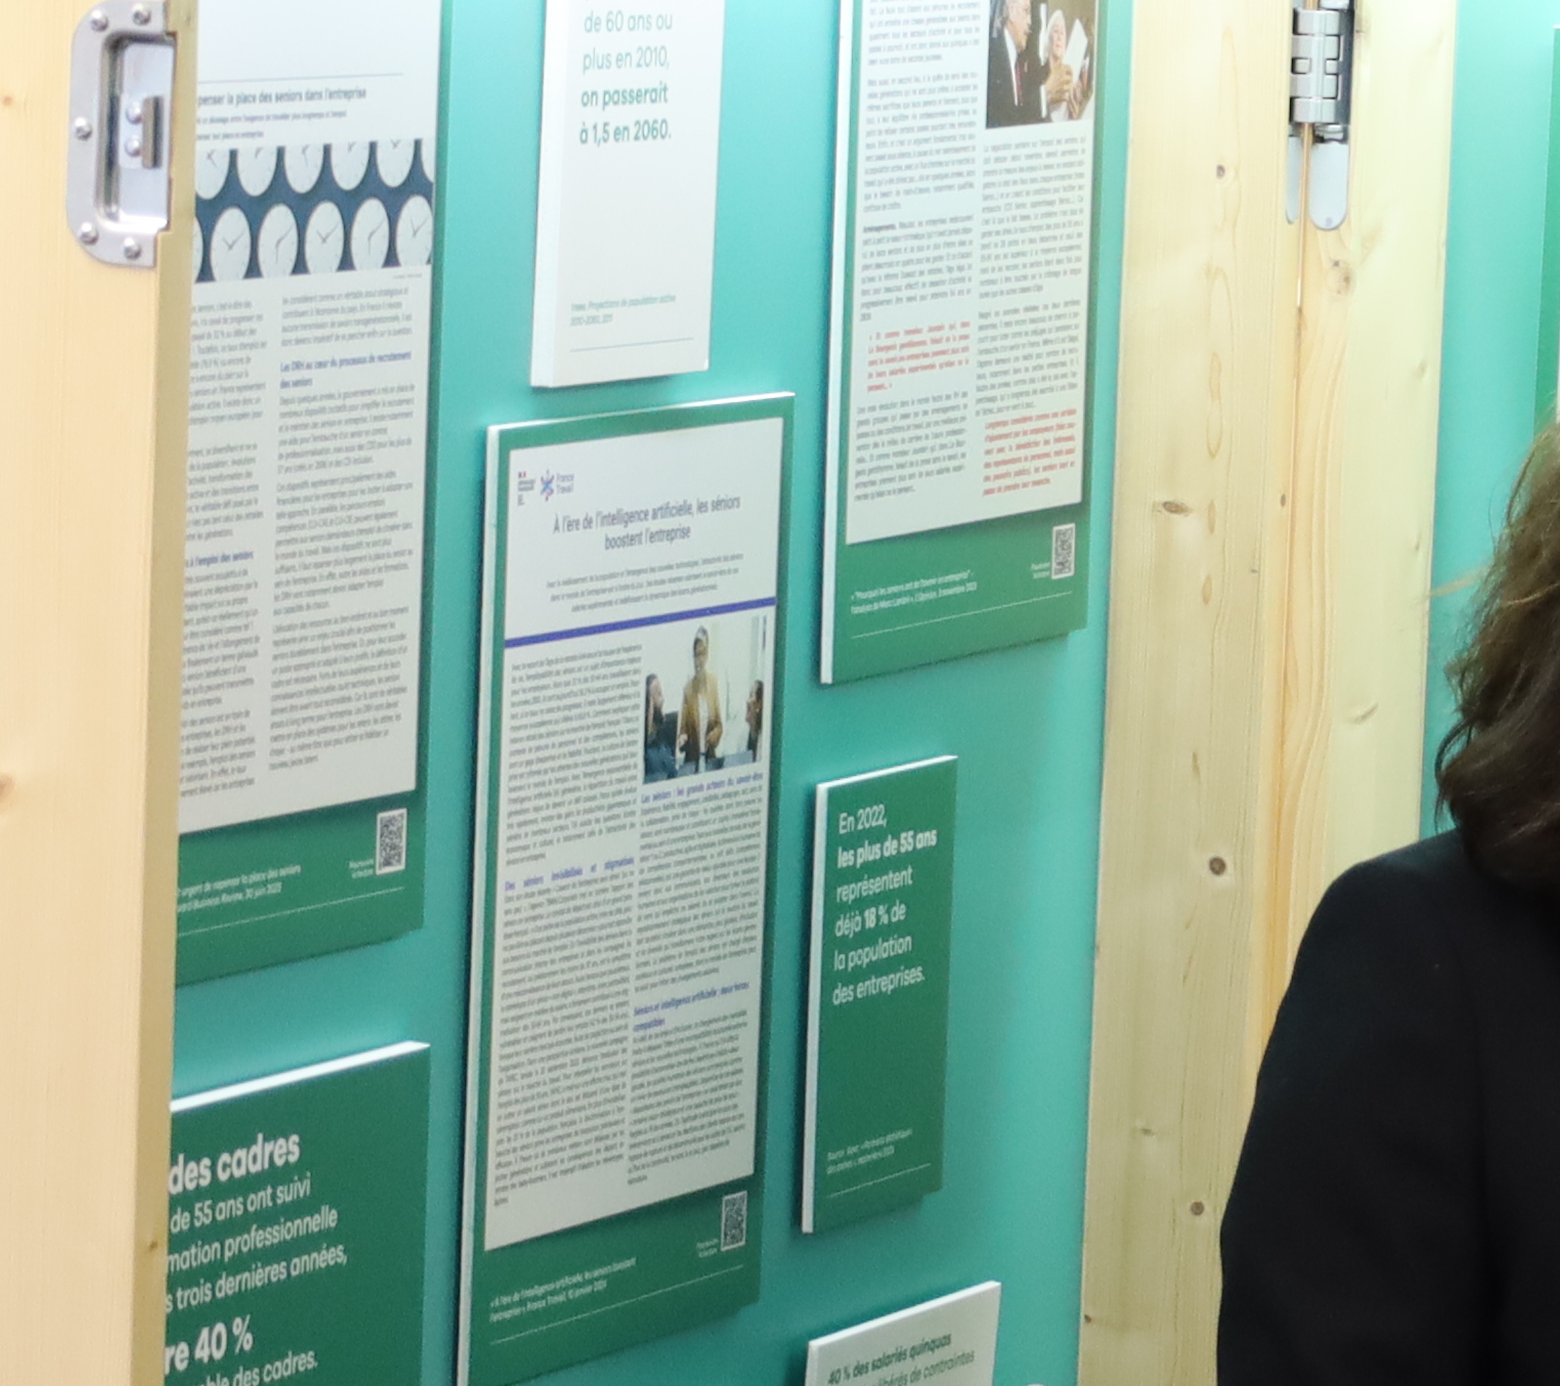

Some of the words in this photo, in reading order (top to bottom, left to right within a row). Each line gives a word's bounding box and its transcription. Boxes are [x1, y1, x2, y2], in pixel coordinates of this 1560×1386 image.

[583, 10, 602, 33] de
[605, 9, 624, 32] 60
[626, 13, 652, 31] ans
[655, 13, 673, 30] ou
[581, 47, 612, 74] plus
[614, 51, 633, 69] en
[635, 45, 669, 68] 2010,
[580, 90, 599, 107] on
[601, 82, 668, 110] passerait
[578, 122, 589, 145] à
[591, 121, 610, 146] 1,5
[612, 125, 630, 142] en
[632, 118, 671, 141] 2060.
[838, 811, 855, 834] En
[856, 804, 887, 830] 2022,
[836, 846, 855, 868] les
[855, 840, 881, 867] plus
[882, 834, 899, 857] de
[898, 830, 914, 853] 55
[914, 829, 937, 849] ans
[835, 866, 913, 903] représentent
[834, 910, 862, 937] déjà
[863, 906, 877, 929] 18
[889, 900, 906, 922] de
[833, 949, 846, 971] la
[847, 935, 912, 971] population
[831, 982, 854, 1005] des
[855, 965, 925, 998] entreprises.
[167, 1153, 212, 1194] des
[216, 1134, 300, 1181] cadres
[169, 1206, 191, 1234] de
[193, 1199, 213, 1227] 55
[214, 1196, 244, 1221] ans
[246, 1184, 273, 1212] ont
[275, 1171, 311, 1204] suivi
